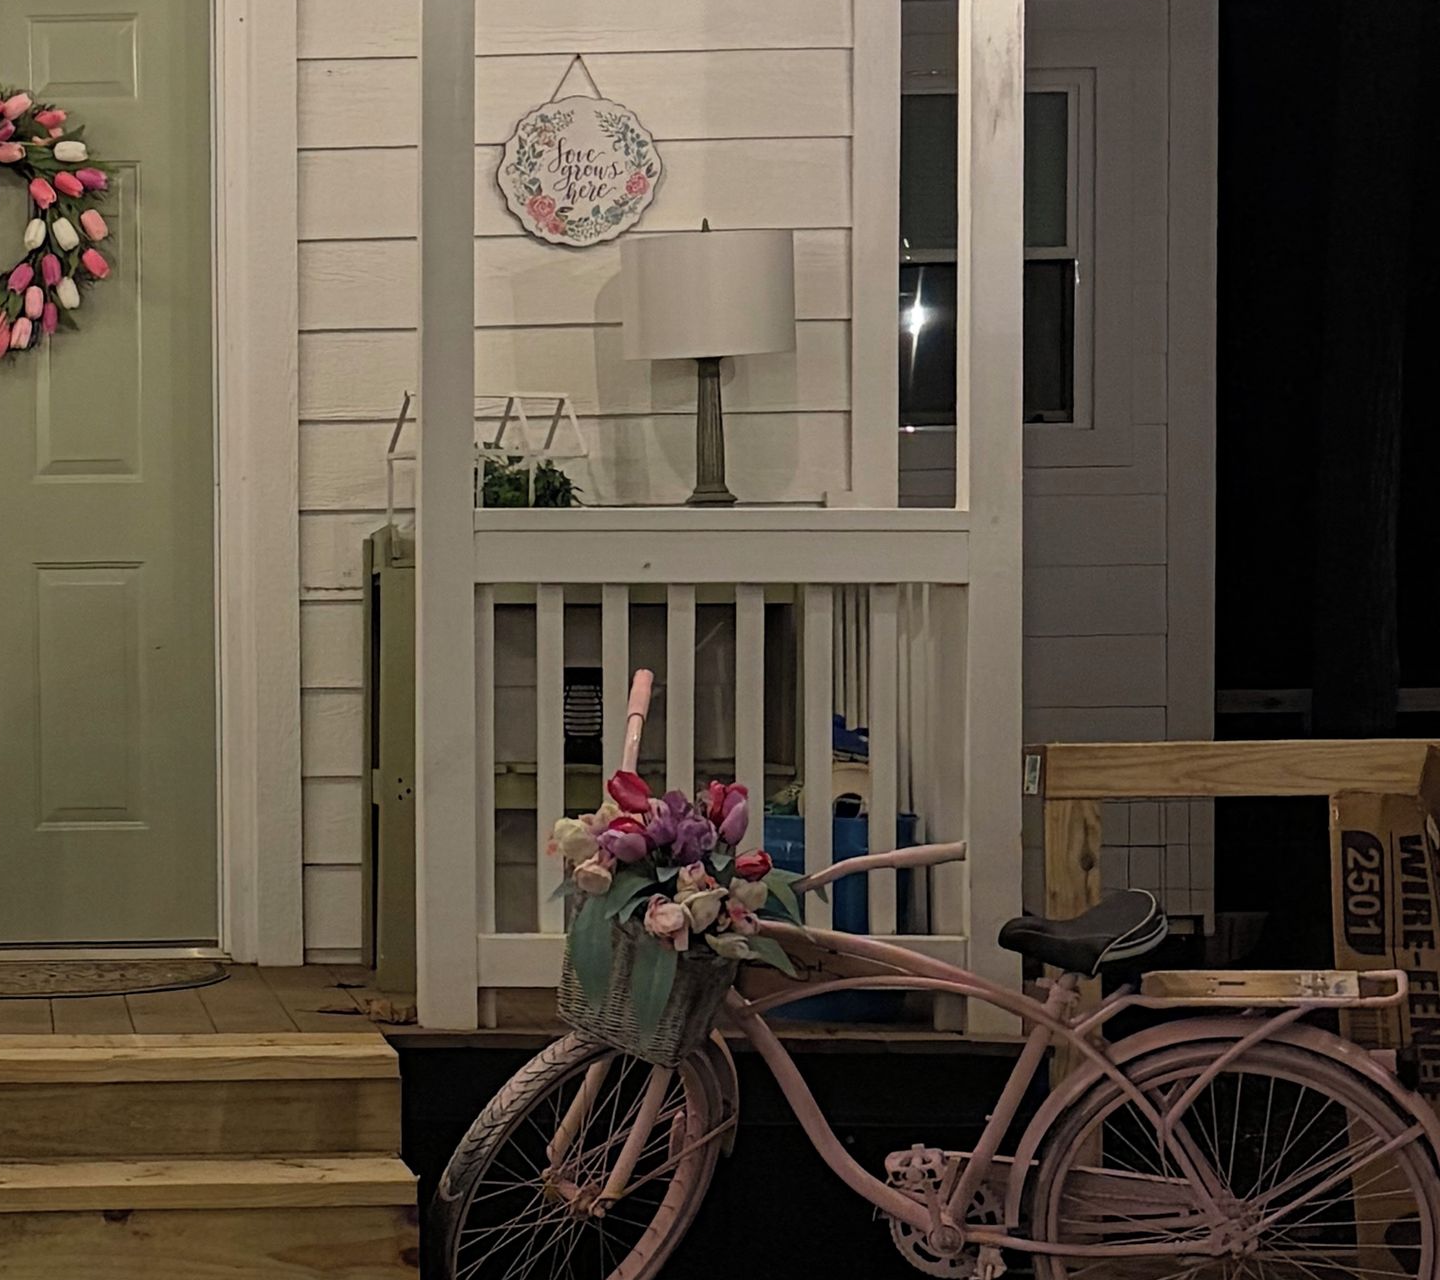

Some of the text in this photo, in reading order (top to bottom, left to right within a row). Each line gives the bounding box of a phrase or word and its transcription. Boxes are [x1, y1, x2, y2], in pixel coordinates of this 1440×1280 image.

[553, 161, 623, 191] grows
[564, 181, 616, 205] here
[1345, 846, 1383, 936] 2501
